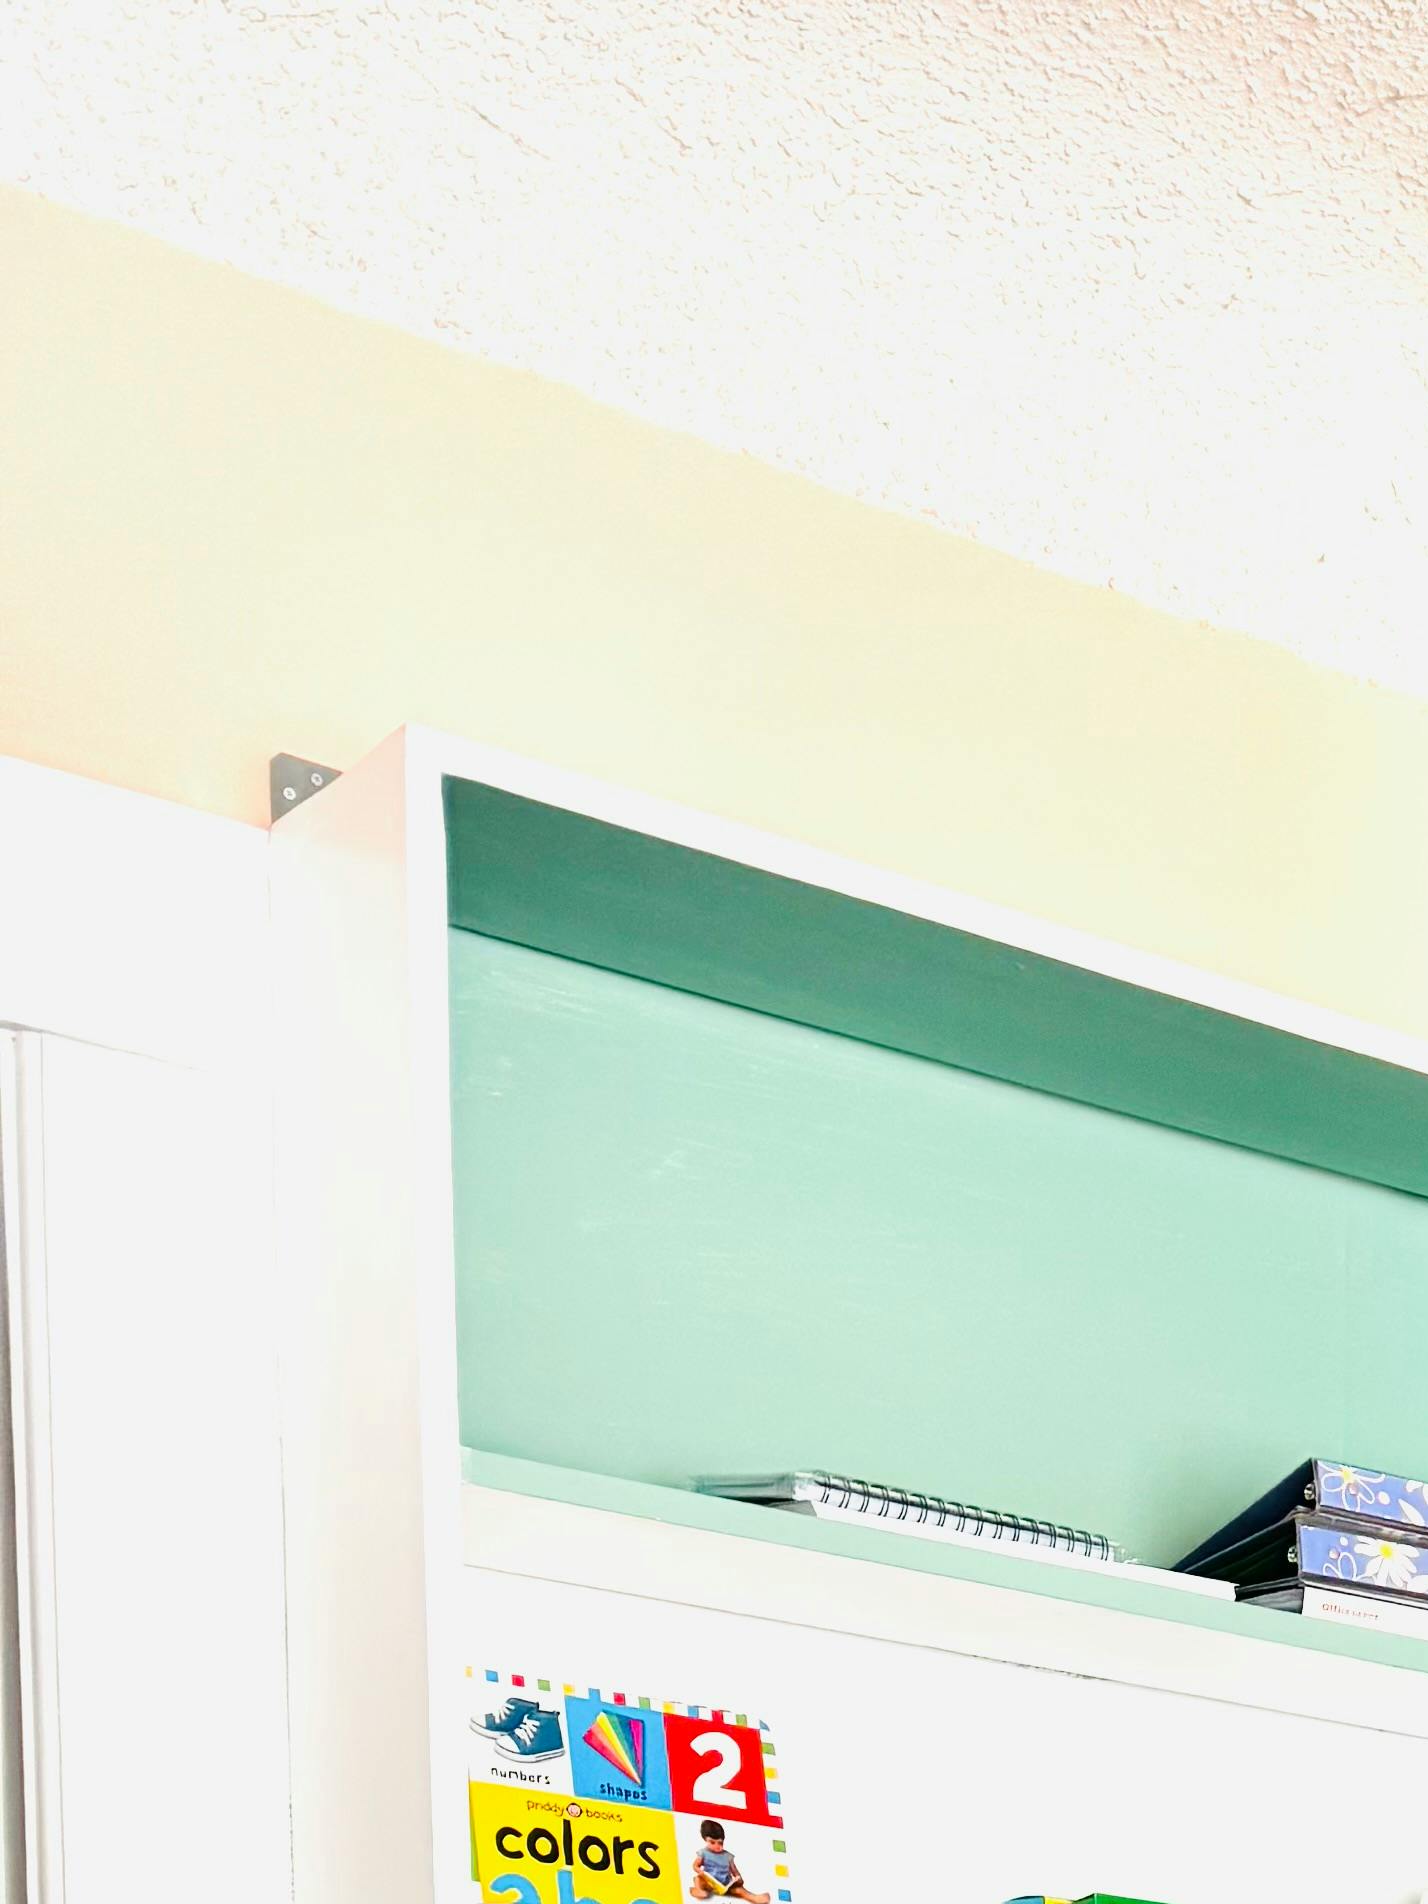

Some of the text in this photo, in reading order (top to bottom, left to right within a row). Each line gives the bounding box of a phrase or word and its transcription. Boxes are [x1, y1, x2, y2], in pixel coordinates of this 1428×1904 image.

[599, 1782, 648, 1801] shapes
[689, 1732, 747, 1809] 2
[526, 1799, 623, 1823] priddy books
[495, 1819, 661, 1879] colors
